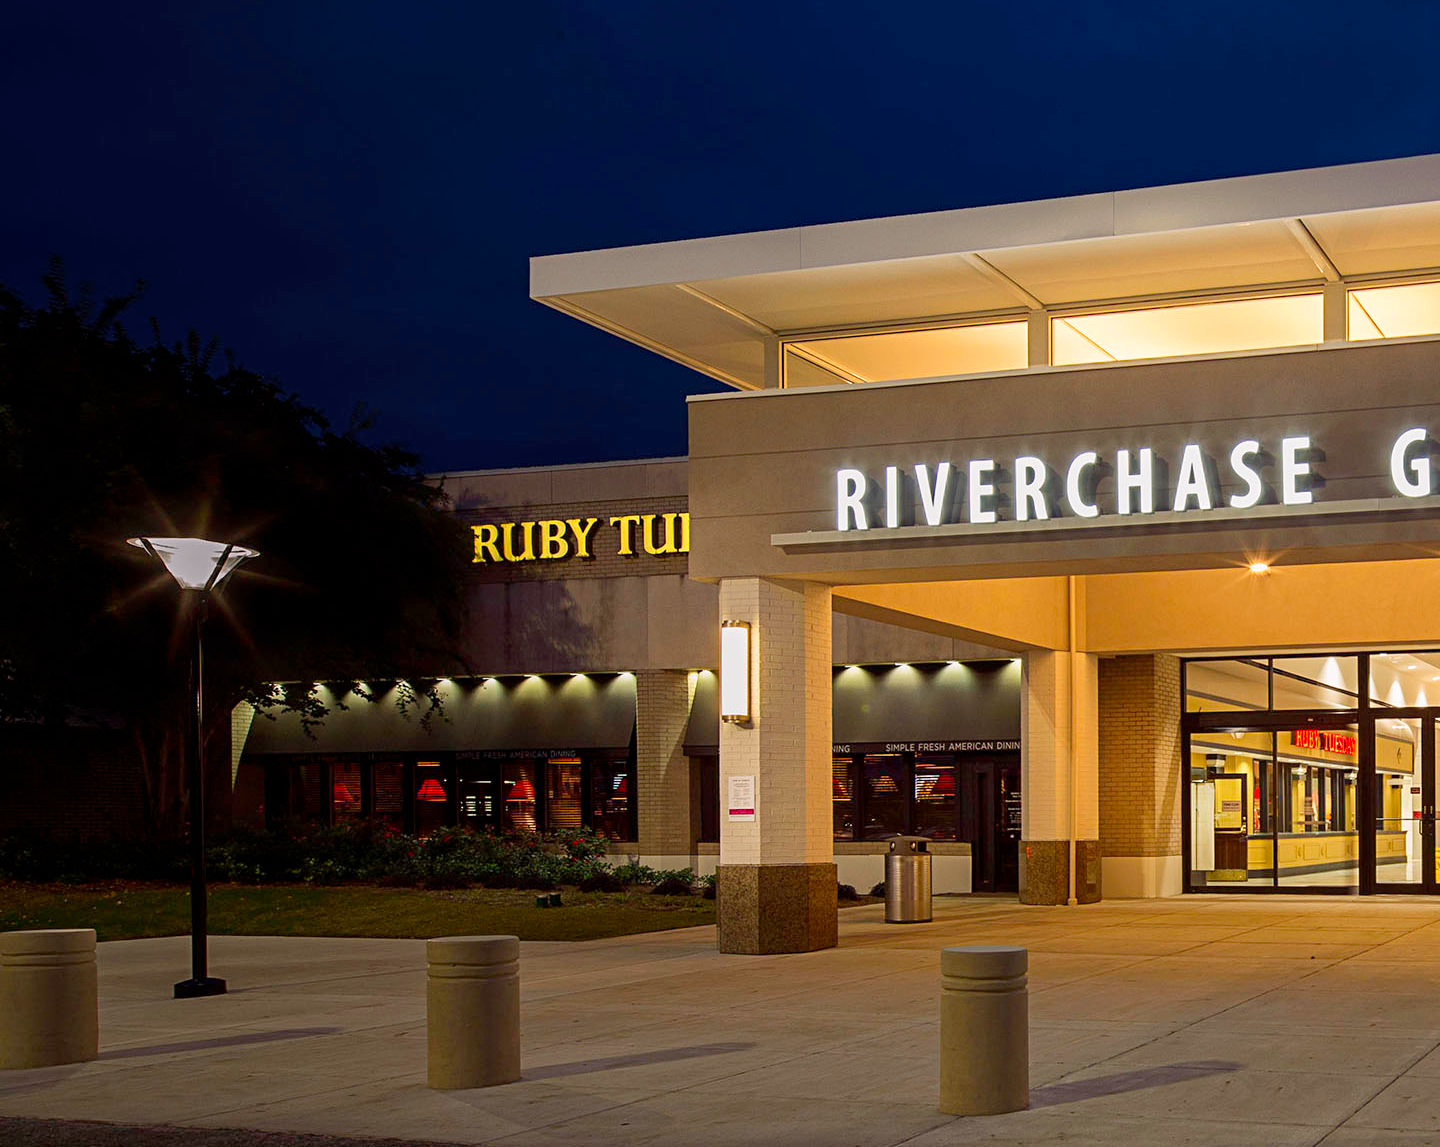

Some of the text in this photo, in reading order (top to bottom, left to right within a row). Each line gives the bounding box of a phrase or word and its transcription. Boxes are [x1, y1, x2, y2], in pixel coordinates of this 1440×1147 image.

[836, 436, 1314, 532] RIVERCHASE
[471, 517, 598, 563] RUBY
[885, 743, 915, 752] SIMPLE
[918, 743, 946, 752] FRESH
[948, 742, 994, 751] AMERICAN
[1296, 730, 1320, 749] RUBY
[509, 750, 548, 759] AMERICAN
[550, 750, 576, 758] DINING
